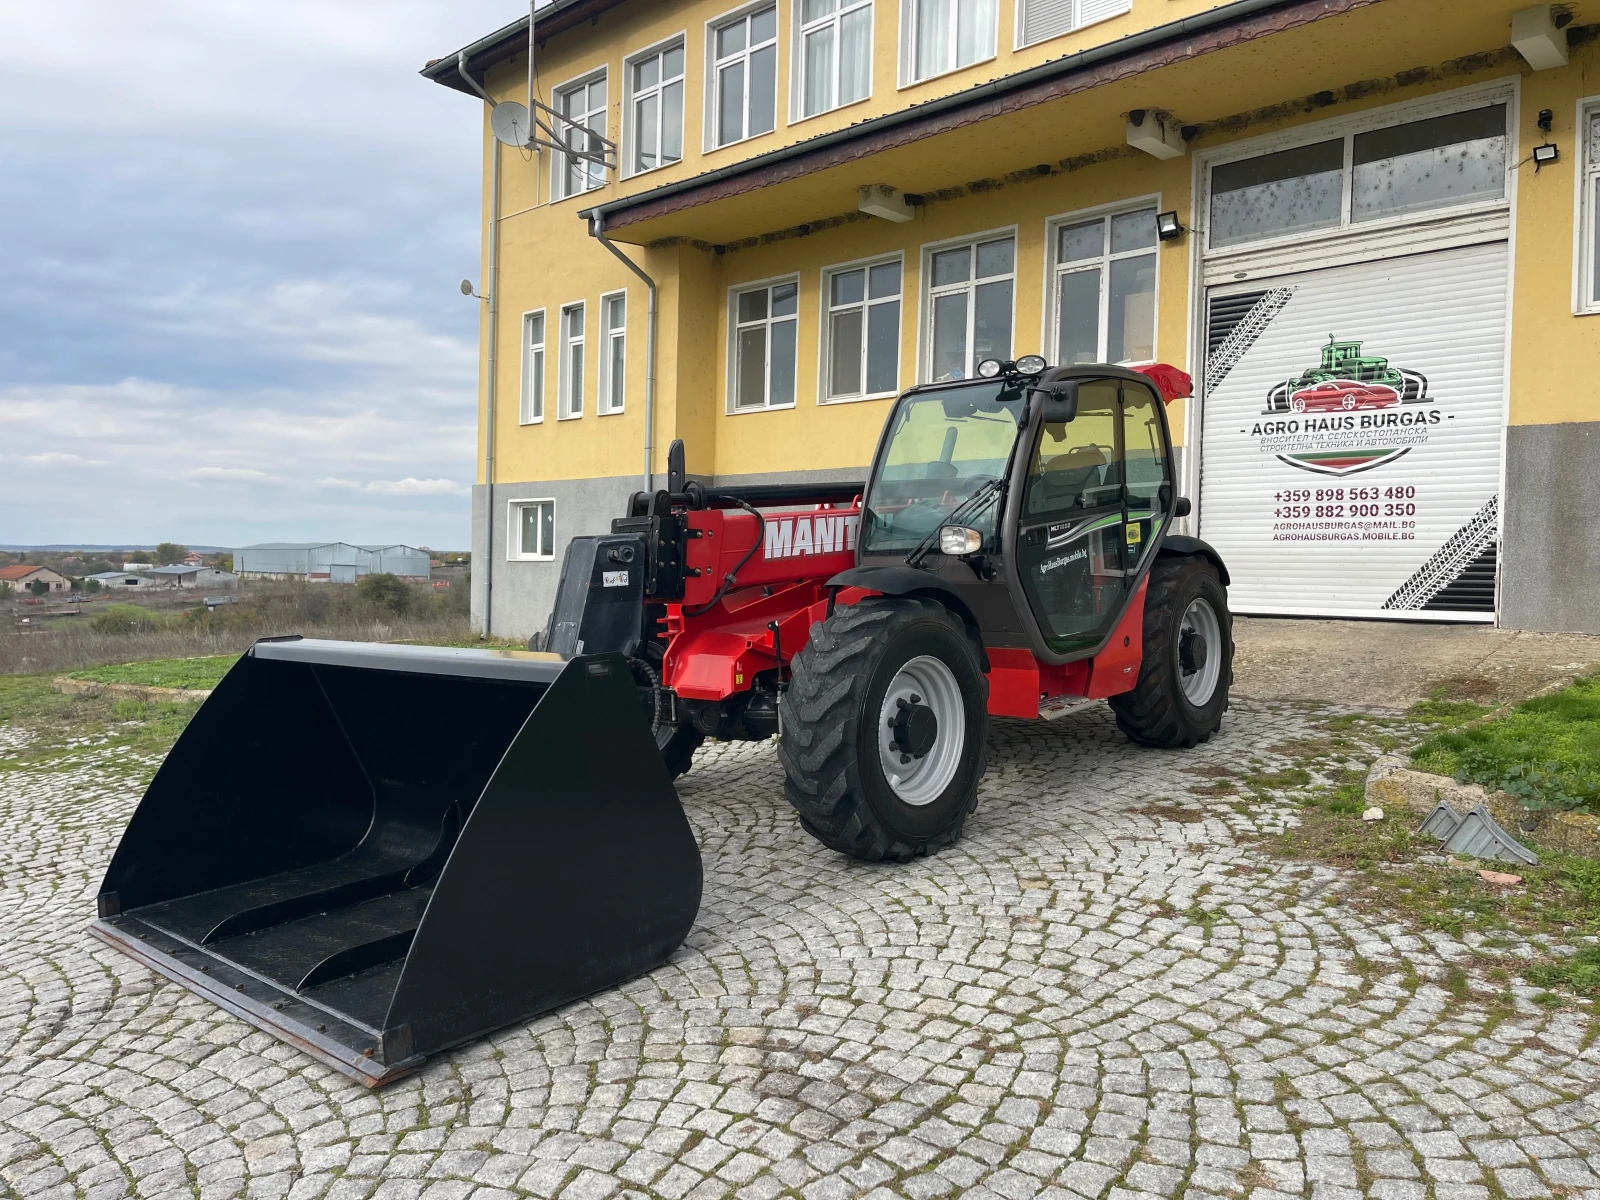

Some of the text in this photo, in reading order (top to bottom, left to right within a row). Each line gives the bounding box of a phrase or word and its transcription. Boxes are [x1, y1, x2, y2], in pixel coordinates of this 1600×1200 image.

[1251, 420, 1299, 436] AGRO
[1304, 416, 1355, 433] HAUS
[1360, 410, 1441, 429] BURGAS
[1261, 427, 1428, 444] ВНОСИТЕЛ НА СЕЛСКОСТОПАНСКА
[1260, 443, 1313, 453] СТРОИТЕЛНА
[1316, 440, 1354, 449] ТЕХНИКА
[1364, 436, 1429, 446] АВТОМОБИЛИ
[1274, 486, 1415, 502] +359 898 563 480
[1274, 503, 1415, 518] +359 882 900 350
[1273, 521, 1416, 531] AGROHAUSBURGAS@MAIL.BG
[765, 515, 860, 559] MANIT
[1273, 532, 1415, 541] AGROHAUSBURGAS.MOBILE.BG
